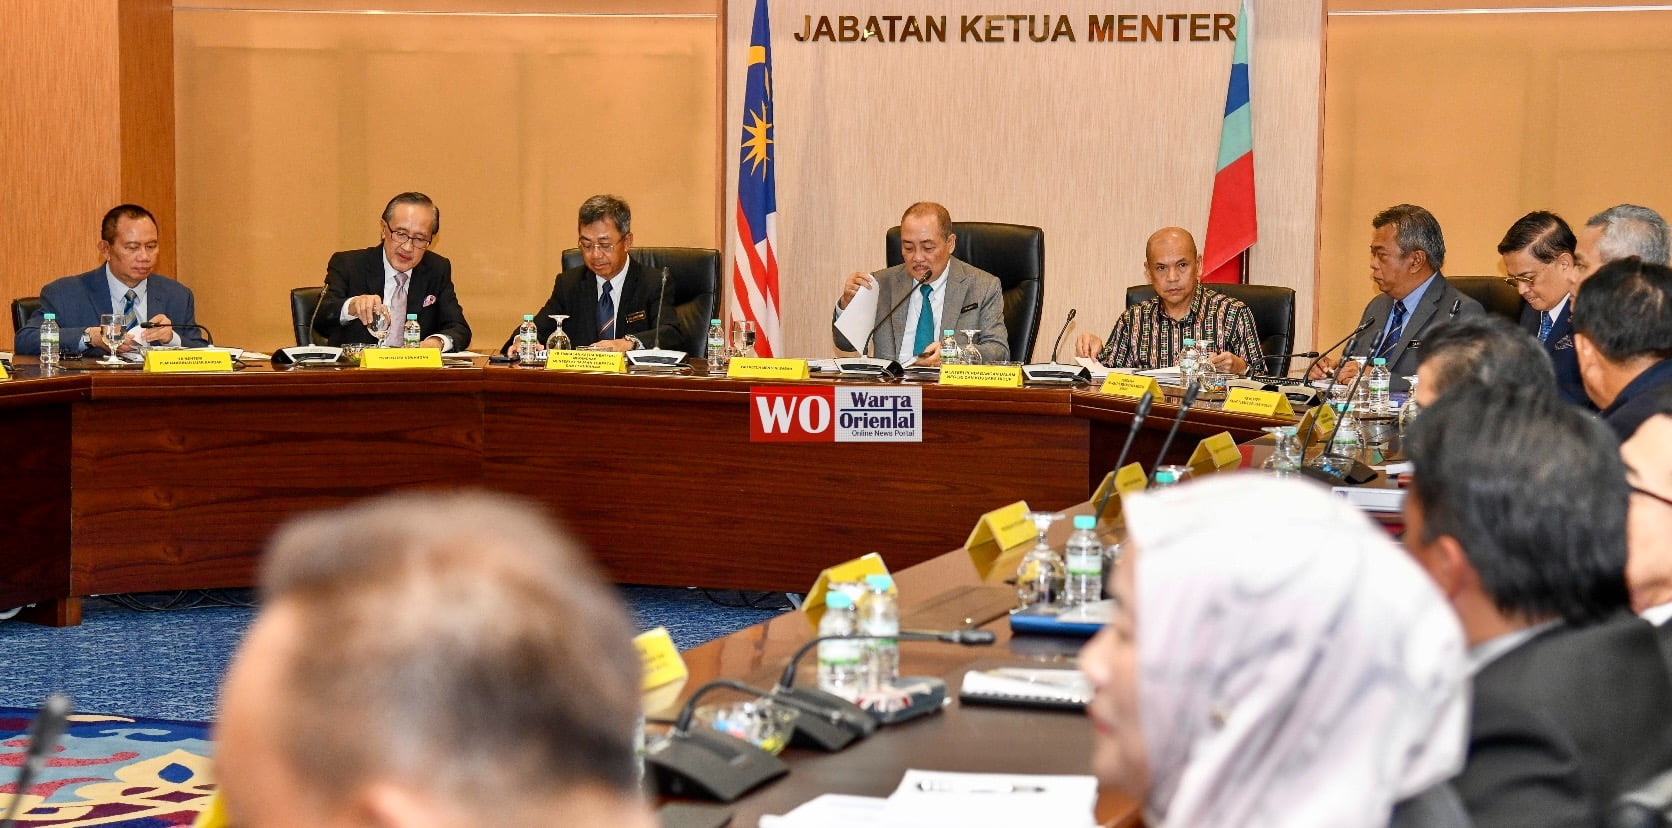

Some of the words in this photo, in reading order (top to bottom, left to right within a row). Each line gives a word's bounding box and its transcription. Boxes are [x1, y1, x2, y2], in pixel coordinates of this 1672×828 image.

[794, 15, 947, 42] JABATAN
[961, 14, 1077, 42] KETUA
[1088, 13, 1236, 41] MENTER
